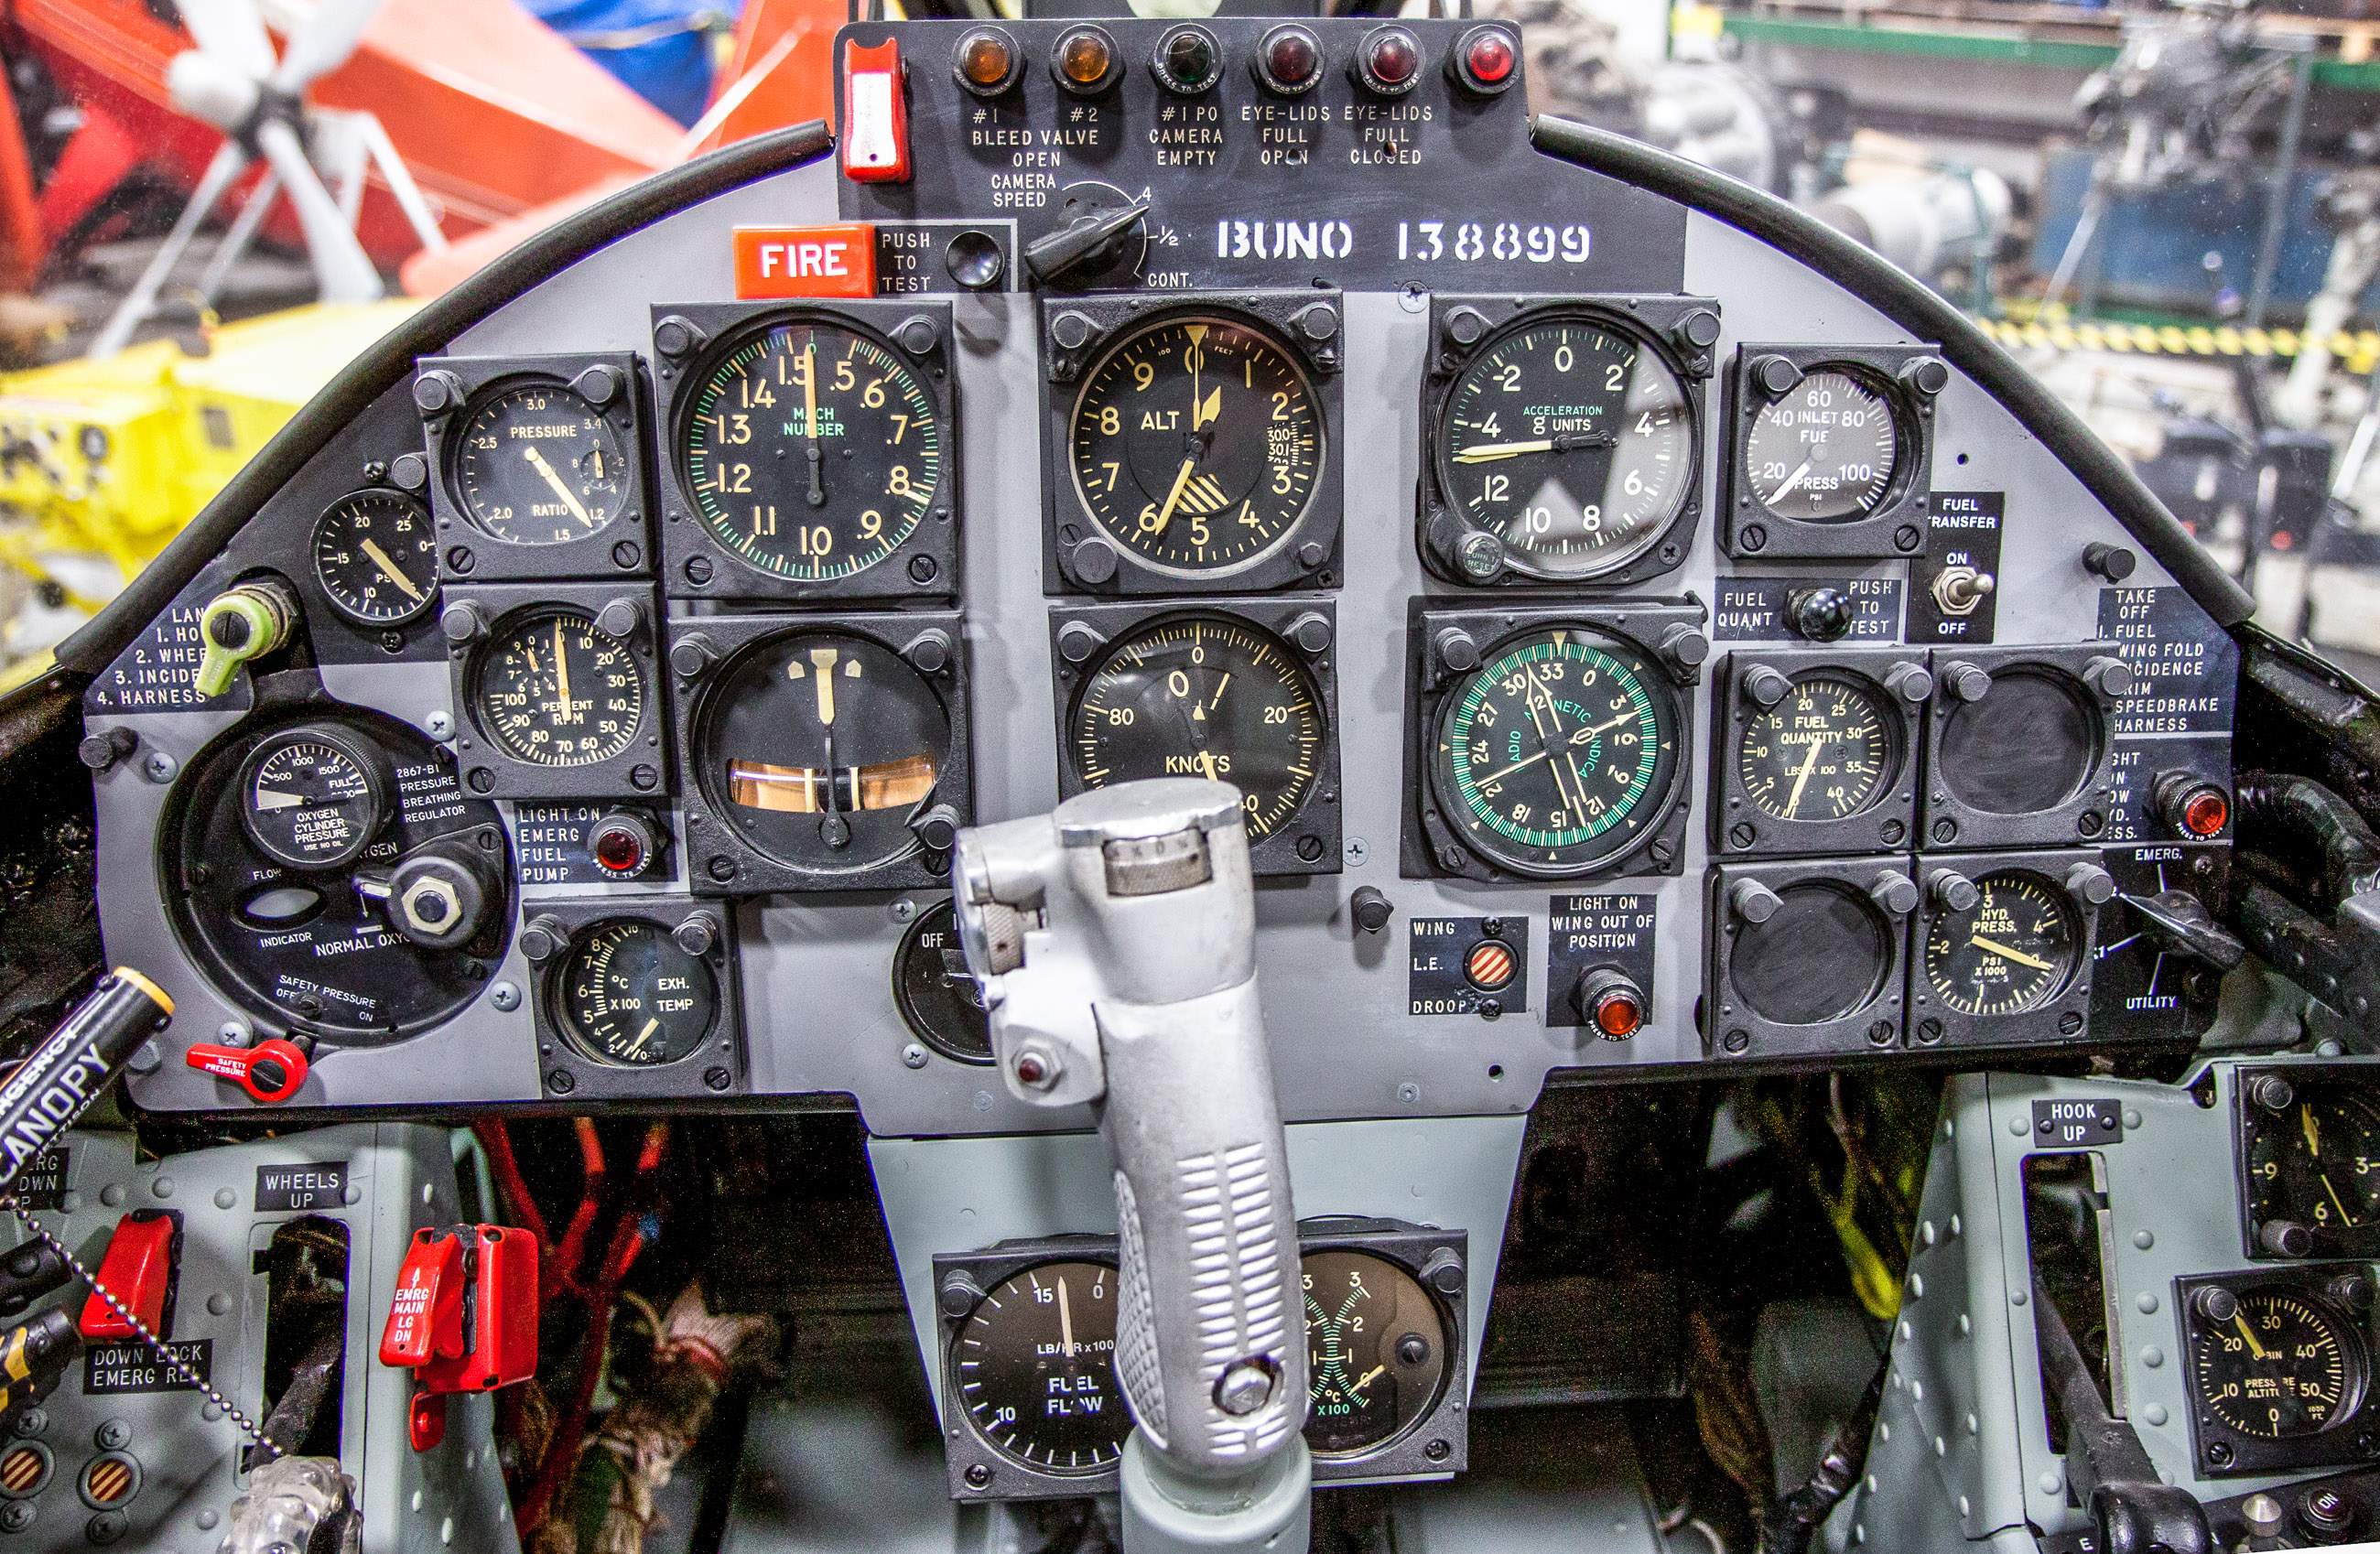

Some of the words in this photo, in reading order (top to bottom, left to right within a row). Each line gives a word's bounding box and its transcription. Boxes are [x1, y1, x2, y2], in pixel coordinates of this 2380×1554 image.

[1241, 105, 1331, 122] EYE-LIDS
[1344, 105, 1433, 122] EYE-LIDS
[972, 129, 1033, 146] BLEED
[1040, 129, 1098, 146] VALVE
[1149, 129, 1223, 144] CAMERA
[1262, 128, 1308, 143] FULL
[1365, 127, 1410, 143] FULL
[1012, 152, 1061, 167] OPEN
[1157, 151, 1217, 166] EMPTY
[1260, 150, 1308, 166] OPN
[990, 174, 1056, 189] CAMERA
[993, 191, 1046, 207] SPEED
[882, 232, 931, 248] PUSH
[1217, 220, 1353, 260] BUNO
[1398, 222, 1591, 264] 138899
[762, 243, 849, 278] FIRE
[893, 255, 916, 270] TO
[882, 276, 931, 292] TEST
[1148, 272, 1194, 288] CONT.
[1214, 345, 1234, 356] FEET
[1806, 390, 1831, 408] 60
[793, 407, 835, 421] MCH
[1522, 405, 1603, 416] ACCELERATION
[1797, 410, 1839, 424] INLET
[1140, 411, 1180, 431] ALT
[1552, 418, 1591, 431] UNITS
[1770, 410, 1793, 427] 40
[1841, 410, 1865, 427] 80
[510, 425, 578, 439] PRESSURE
[1763, 462, 1786, 480] 20
[1838, 464, 1871, 481] 100
[1484, 474, 1509, 502] 12
[1794, 477, 1839, 491] PRESS
[533, 503, 568, 516] RATIO
[1942, 498, 1978, 512] FUEL
[354, 516, 371, 528] 20
[396, 520, 412, 532] 25
[1525, 506, 1552, 534] 10
[337, 552, 350, 564] 15
[1946, 552, 1967, 565] ON
[364, 587, 376, 598] 10
[1849, 580, 1892, 596] PUSH
[1725, 592, 1767, 607] FUEL
[2115, 589, 2156, 604] TAKE
[1859, 600, 1879, 615] TO
[2119, 605, 2150, 620] OFF
[1717, 612, 1773, 627] QUANT
[1938, 622, 1966, 635] OFF
[2115, 624, 2157, 639] FUEL
[2118, 642, 2158, 657] WING
[2164, 642, 2204, 657] FOLD
[597, 653, 614, 665] 20
[1540, 663, 1565, 681] 33
[608, 674, 626, 688] 30
[121, 690, 207, 705] HARNESS
[609, 698, 627, 711] 40
[1798, 698, 1813, 711] 20
[2115, 697, 2219, 713] SPEEDBRAKE
[1109, 707, 1134, 726] 80
[1263, 707, 1288, 724] 20
[1831, 704, 1846, 717] 25
[513, 714, 531, 727] 90
[600, 720, 618, 733] 50
[1770, 717, 1783, 729] 15
[1794, 716, 1830, 729] FUEL
[2114, 718, 2188, 732] HARNESS
[531, 730, 549, 743] 80
[1846, 728, 1863, 739] 30
[557, 740, 573, 753] 70
[580, 738, 599, 750] 60
[291, 756, 314, 767] 1000
[1845, 761, 1862, 773] 35
[318, 764, 341, 775] 1500
[328, 779, 354, 790] FULL
[400, 776, 456, 793] PRESSURE
[1826, 786, 1844, 798] 40
[403, 791, 461, 809] BREATHING
[296, 808, 340, 823] OXYGEN
[404, 804, 466, 824] REGULATOR
[519, 807, 569, 823] LIGHT
[579, 807, 600, 821] ON
[294, 817, 346, 834] CYLINDER
[294, 827, 351, 845] PRESSURE
[520, 827, 579, 843] EMERG
[521, 847, 567, 862] FUEL
[2135, 847, 2184, 861] EMERG.
[523, 867, 569, 881] PUMP
[1569, 897, 1611, 911] LIGHT
[1618, 896, 1639, 911] ON
[1981, 908, 2009, 921] HYD.
[1413, 922, 1455, 936] WING
[1552, 916, 1594, 931] WING
[1600, 915, 1629, 929] OUT
[1636, 914, 1654, 929] OF
[1972, 920, 2018, 933] PRESS.
[260, 932, 312, 948] INDICATOR
[315, 937, 374, 957] NORMAL
[922, 933, 944, 948] OFF
[1569, 933, 1637, 948] POSITION
[1413, 957, 1444, 971] L.E.
[1982, 956, 2001, 966] PSI
[1984, 966, 2007, 977] 1000
[658, 977, 690, 991] EXH.
[278, 975, 319, 993] SAFETY
[322, 987, 376, 1009] PRESSURE
[656, 998, 694, 1012] TEMP
[1412, 999, 1466, 1014] DROOP
[2126, 995, 2178, 1010] UTILITY
[359, 1010, 373, 1023] ON
[205, 1063, 246, 1077] PRESSURE
[218, 1058, 247, 1070] SAFETY
[2050, 1103, 2097, 1119] HOOK
[2063, 1125, 2087, 1141] UP
[265, 1172, 340, 1191] WHEELS
[290, 1192, 313, 1209] UP
[395, 1288, 430, 1301] EMRG
[1033, 1288, 1054, 1303] 15
[394, 1301, 425, 1314] MAIN
[398, 1316, 414, 1328] LG
[2261, 1315, 2281, 1330] 30
[394, 1330, 412, 1343] DN
[2223, 1338, 2243, 1352] 20
[2296, 1344, 2316, 1358] 40
[94, 1349, 144, 1366] DOWN
[93, 1366, 156, 1387] EMERG
[2223, 1383, 2239, 1398] 10
[2299, 1383, 2320, 1398] 50
[996, 1407, 1015, 1423] 10
